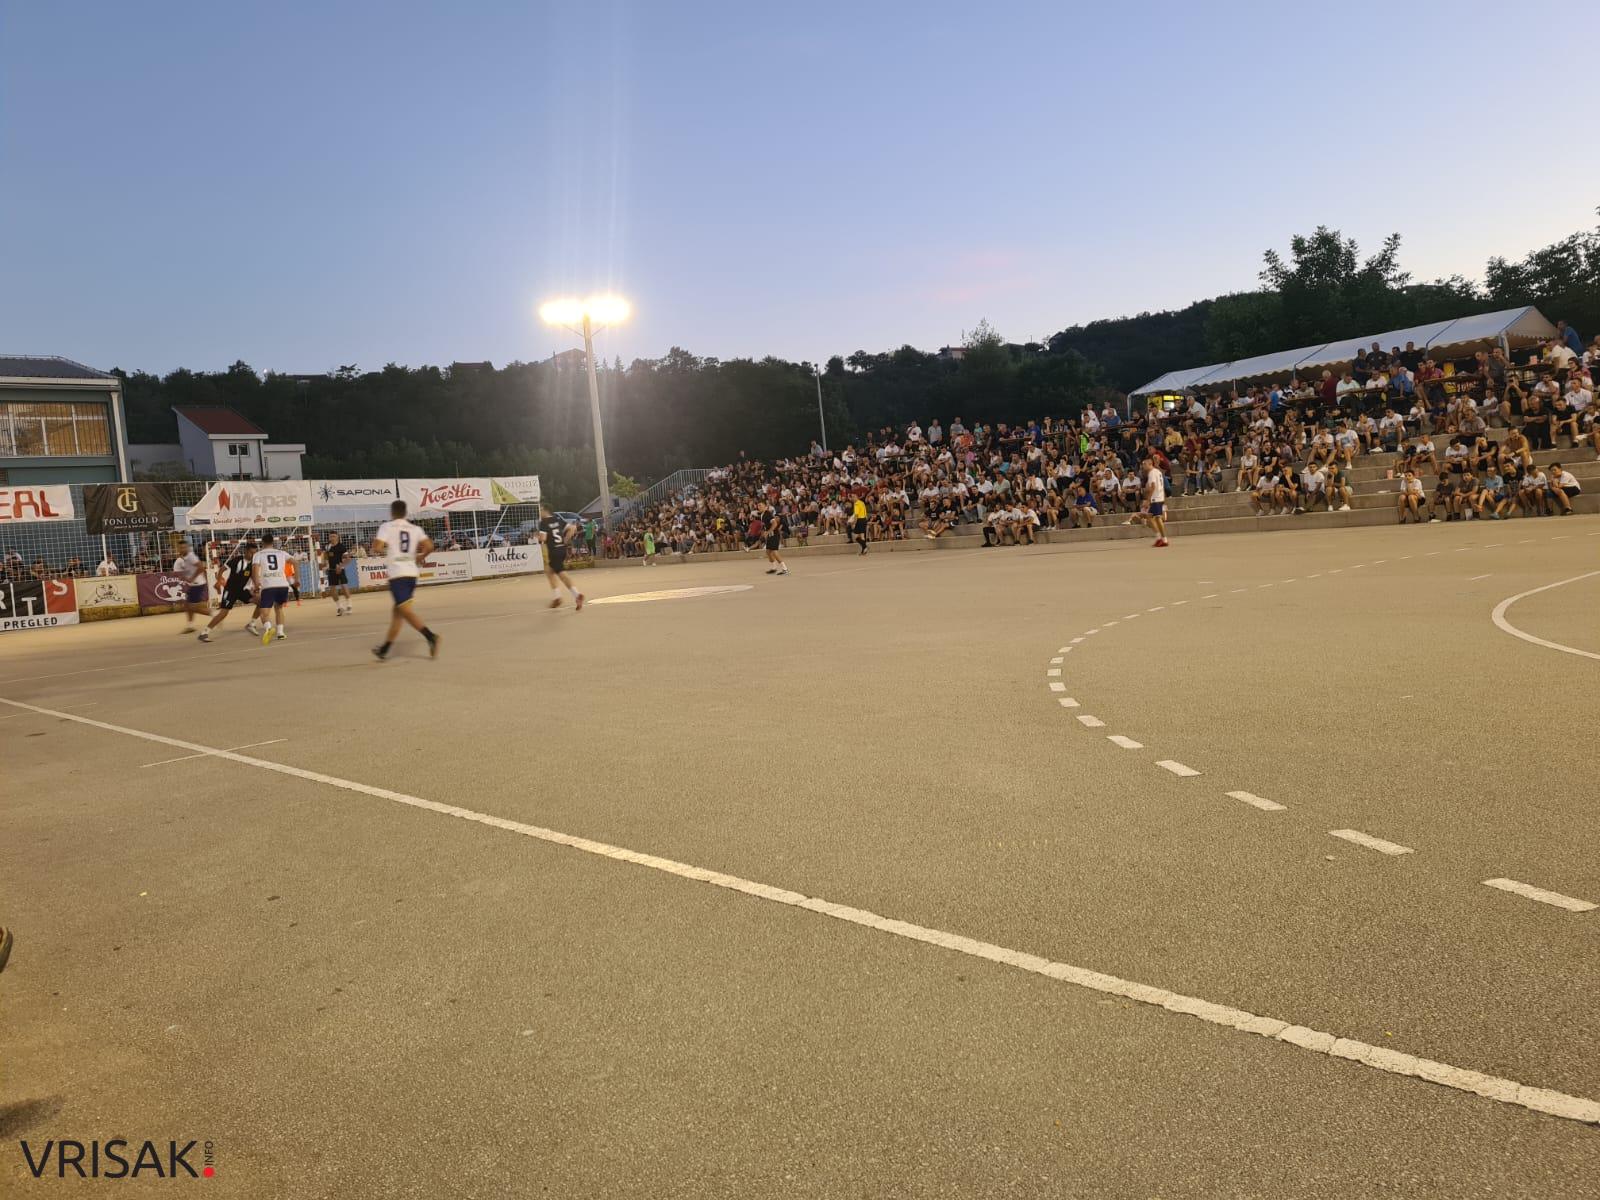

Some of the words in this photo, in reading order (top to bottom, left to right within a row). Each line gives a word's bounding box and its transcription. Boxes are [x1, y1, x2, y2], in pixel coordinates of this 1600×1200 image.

[336, 488, 392, 496] SAPONIA
[420, 483, 480, 507] Koestlin
[232, 493, 297, 512] Mepas
[103, 518, 127, 526] TONI
[130, 516, 158, 525] GOLD
[400, 531, 409, 553] 8
[552, 529, 562, 543] 5
[267, 554, 278, 570] 9
[3, 616, 58, 629] PREGLED
